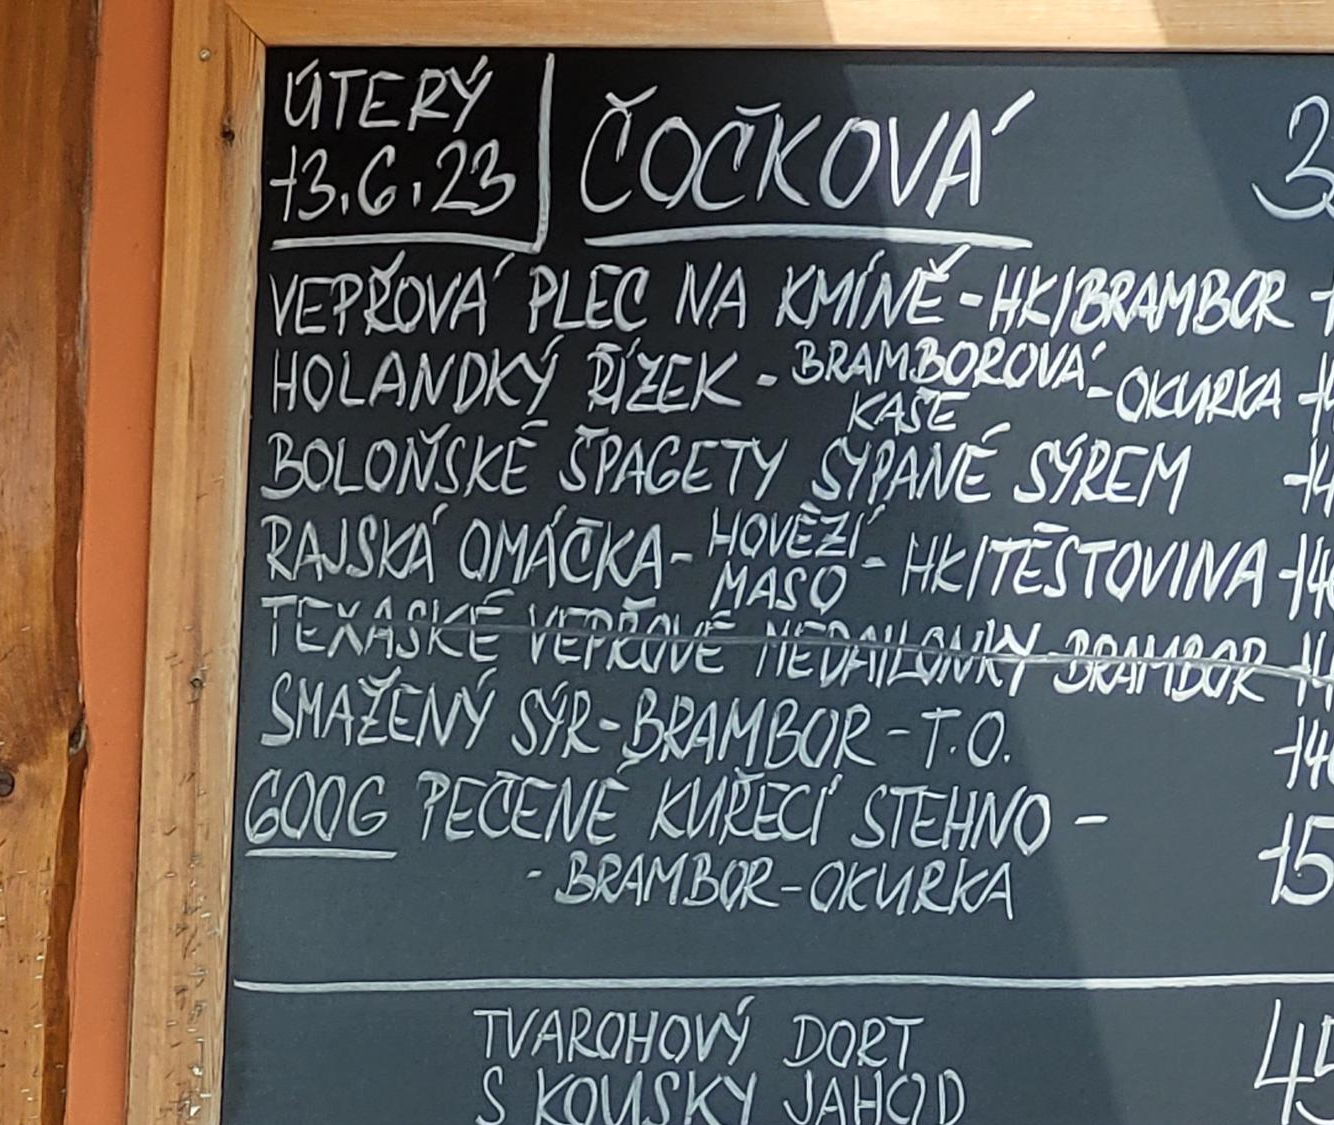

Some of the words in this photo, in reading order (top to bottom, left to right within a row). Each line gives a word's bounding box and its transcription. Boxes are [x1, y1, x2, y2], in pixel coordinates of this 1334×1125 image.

[285, 55, 493, 132] ÚTERÝ
[580, 85, 1036, 218] ČOČKOVÁ
[269, 250, 516, 337] VEPŘOVÁ
[528, 263, 651, 335] PLEC
[675, 261, 747, 330] NA
[271, 334, 565, 414] HOLANDKÝ
[587, 337, 743, 413] ŘÍZEK
[260, 419, 549, 498] BOLOŇSKÉ
[558, 423, 789, 500] ŠPAGETY
[1013, 433, 1193, 515] SÝREM
[260, 502, 449, 583] RAJSKÁ
[710, 560, 847, 616] MASO
[261, 666, 498, 749] SMAŽENÝ
[244, 768, 387, 845] 600G
[650, 766, 843, 847] KUŘECÍ
[850, 783, 1051, 856] STEHNO
[473, 995, 756, 1066] TVAROHOVÝ
[783, 1014, 924, 1070] DORT
